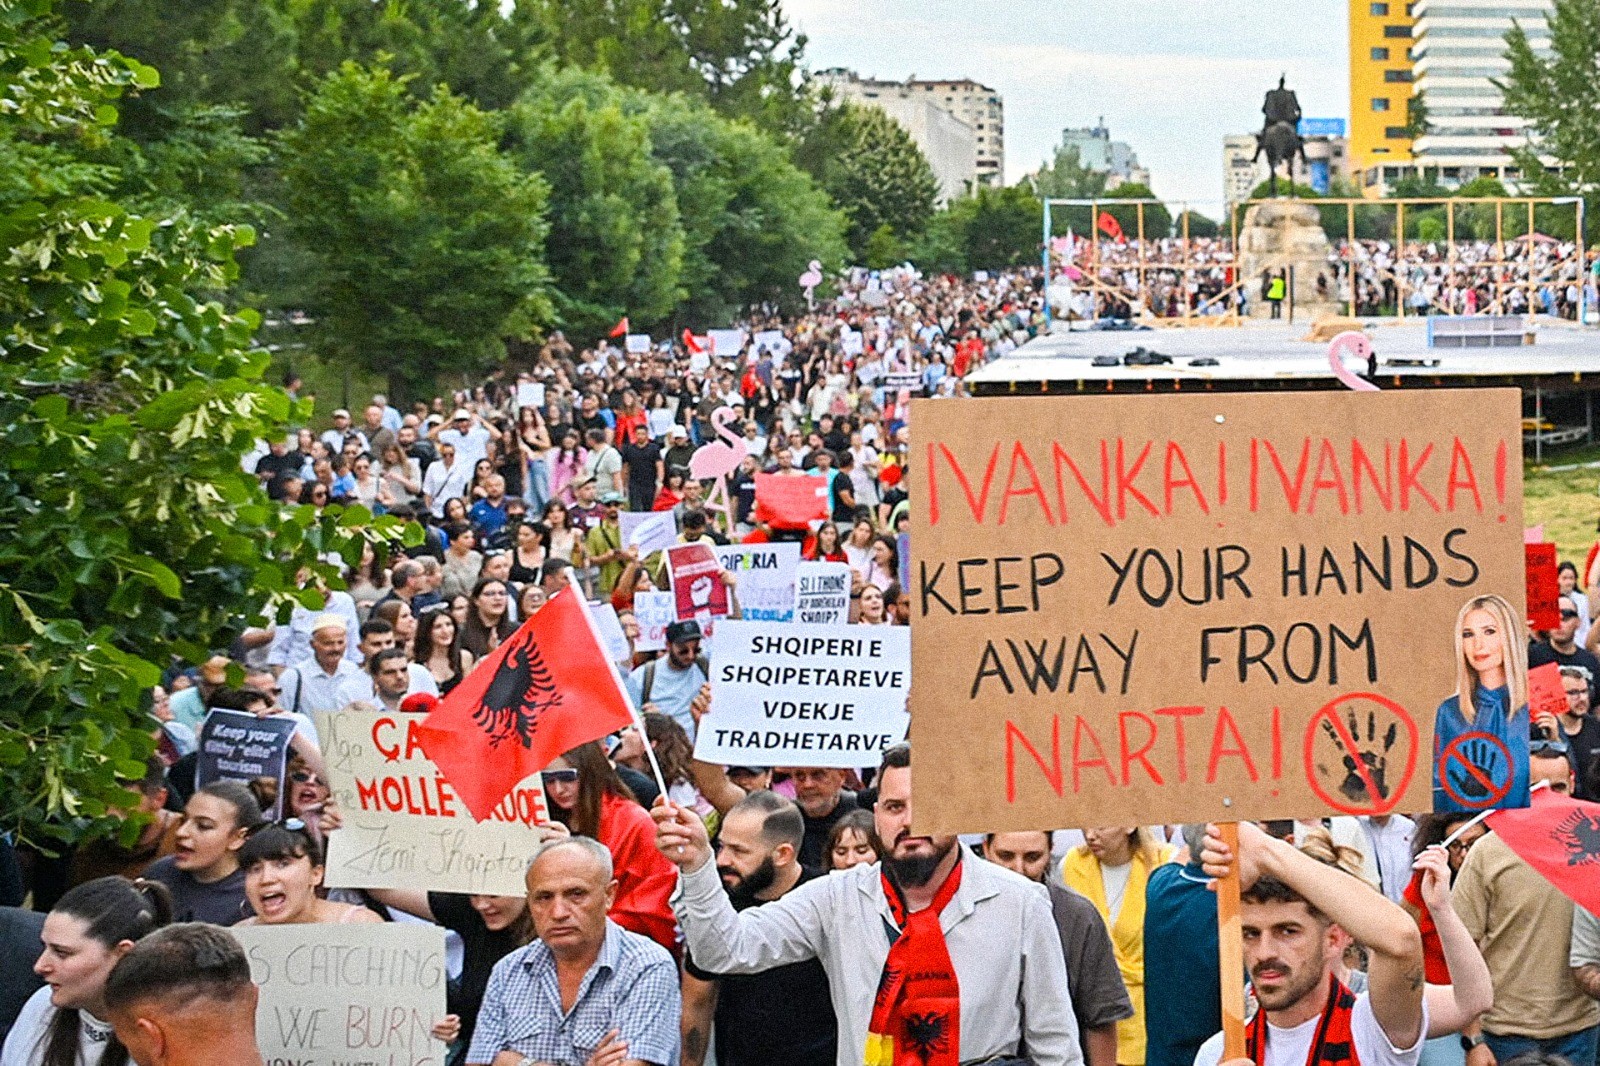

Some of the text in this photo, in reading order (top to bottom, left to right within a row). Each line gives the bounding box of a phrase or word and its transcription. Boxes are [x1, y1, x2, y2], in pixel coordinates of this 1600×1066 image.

[927, 436, 1508, 528] IVANKA! IVANKA!
[921, 553, 1063, 616] KEEP
[1102, 545, 1251, 608] YOUR
[1282, 528, 1480, 596] HANDS
[751, 636, 882, 657] SHQIPERI E
[972, 619, 1377, 698] AWAY FROM
[721, 665, 902, 688] SHQIPETAREVE
[763, 701, 854, 721] VDEKJE
[715, 730, 892, 751] TRADHETARVE
[1005, 705, 1282, 803] NARTA!
[285, 943, 441, 990] CATCHING
[274, 1003, 434, 1049] WE BURN
